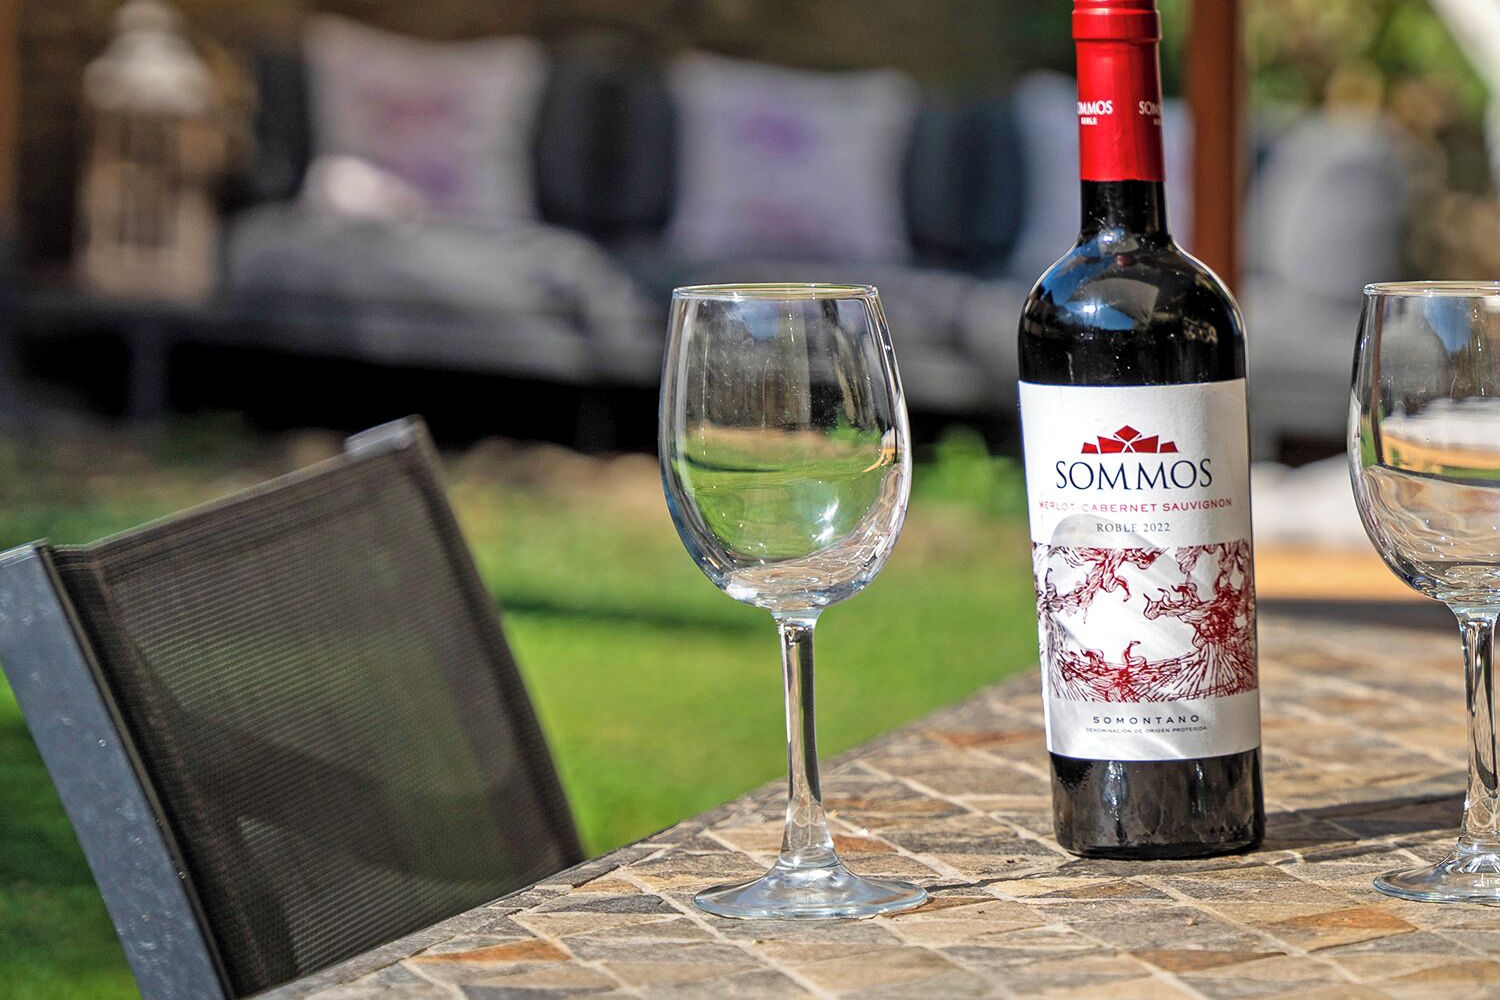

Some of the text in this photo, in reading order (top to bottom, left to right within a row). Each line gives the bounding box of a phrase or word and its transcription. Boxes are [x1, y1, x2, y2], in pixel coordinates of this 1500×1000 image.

[1056, 458, 1213, 490] SOMMOS
[1162, 498, 1232, 512] SAUVIGNON
[1096, 522, 1171, 533] ROBLE 2022
[1093, 715, 1199, 725] SOMONTANO
